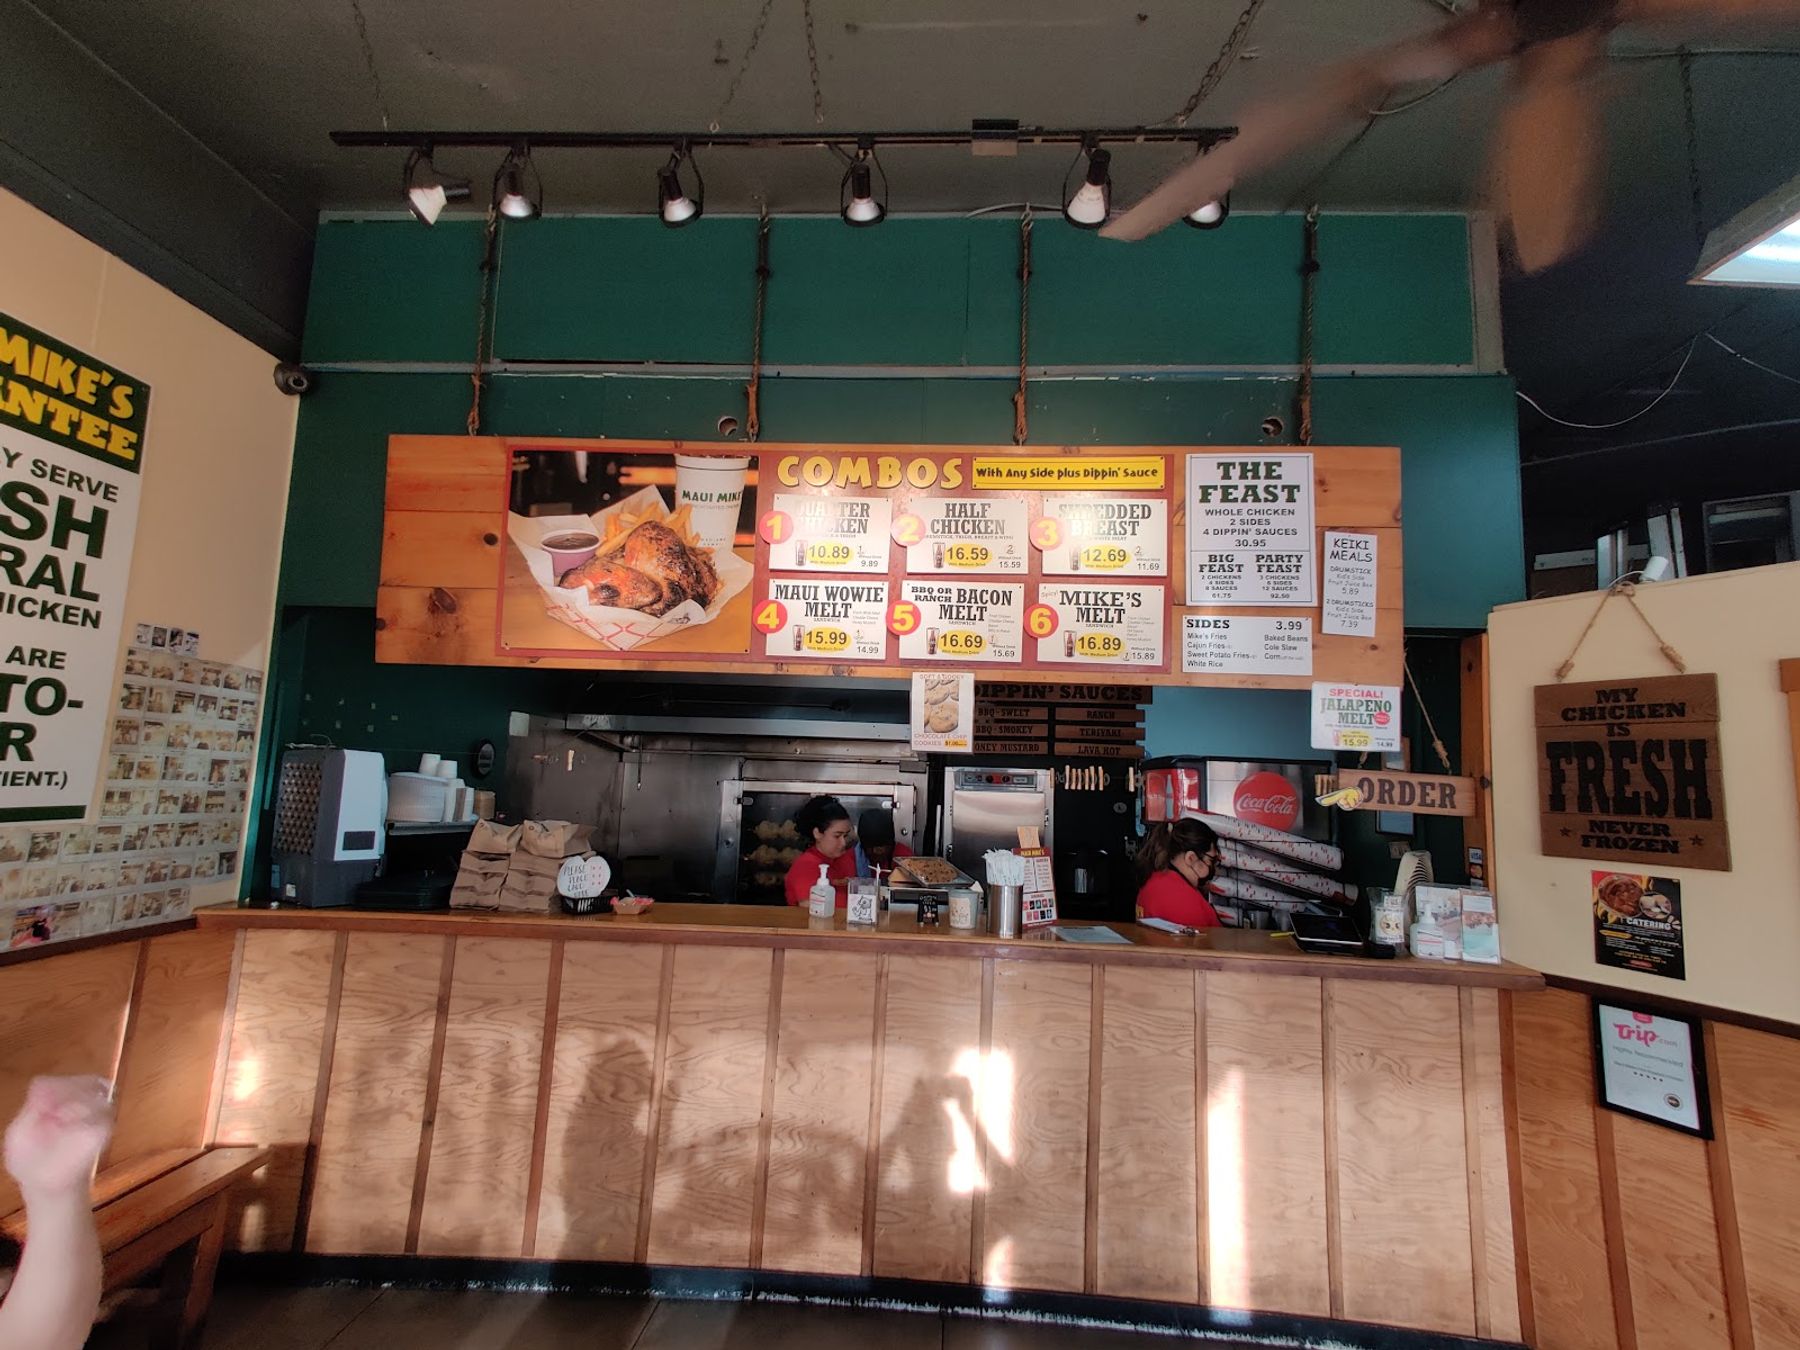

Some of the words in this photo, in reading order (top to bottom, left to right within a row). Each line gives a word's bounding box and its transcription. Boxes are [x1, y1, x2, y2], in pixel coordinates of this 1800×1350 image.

[0, 326, 134, 419] MIKE'S
[777, 456, 963, 489] COMBOS
[976, 467, 1002, 478] With
[1006, 468, 1027, 479] Any
[1030, 468, 1054, 478] Side
[1058, 467, 1080, 480] plus
[1084, 467, 1120, 480] Dippin'
[1123, 468, 1158, 478] Sauce
[1217, 462, 1282, 480] THE
[30, 458, 119, 503] SERVE
[682, 490, 713, 502] MAUI
[1199, 484, 1300, 503] FEAST
[945, 503, 992, 518] HALF
[1059, 504, 1152, 520] SHREDDED
[766, 515, 782, 540] 1
[899, 516, 920, 542] 2
[930, 520, 1006, 534] CHICKEN
[1037, 520, 1058, 546] 3
[1235, 539, 1266, 547] 30.95
[1334, 538, 1369, 550] KEIKI
[810, 545, 850, 559] 10.89
[947, 548, 988, 560] 16.59
[1084, 549, 1126, 562] 12.69
[1208, 554, 1234, 562] BIG
[1256, 554, 1304, 562] PARTY
[1330, 550, 1372, 562] MEALS
[1199, 564, 1244, 572] FEAST
[1257, 564, 1302, 572] FEAST
[1330, 566, 1372, 574] DRUMSTICK
[775, 584, 819, 600] MAUI
[825, 586, 884, 602] WOWIE
[912, 586, 934, 594] BBQ
[956, 588, 1012, 606] BACON
[1060, 590, 1142, 608] MIKE'S
[757, 603, 780, 629] 4
[805, 602, 852, 618] MELT
[939, 604, 988, 621] MELT
[1076, 608, 1126, 624] MELT
[892, 604, 914, 632] 5
[1030, 608, 1052, 634] 6
[1186, 619, 1230, 628] SIDES
[1276, 621, 1302, 630] 3.99
[806, 632, 848, 645] 15.99
[941, 634, 982, 648] 16.69
[1078, 636, 1122, 651] 16.89
[5, 646, 66, 670] ARE
[1060, 686, 1143, 700] SAUCES
[1329, 688, 1384, 698] SPECIAL!
[1596, 688, 1638, 704] MY
[1320, 698, 1392, 714] JALAPENO
[1561, 703, 1686, 722] CHICKEN
[1086, 710, 1115, 719] RANCH
[1338, 712, 1374, 724] MELT
[999, 726, 1032, 734] SMOKEY
[1080, 728, 1121, 736] TERIYAKI
[1607, 723, 1630, 736] IS
[975, 743, 996, 752] ONEY
[1000, 744, 1040, 752] MUSTARD
[1078, 746, 1099, 754] LAVA
[1102, 747, 1121, 755] HOT
[0, 770, 67, 790] IENT.)
[1546, 739, 1713, 820] FRESH
[1358, 776, 1456, 808] ORDER
[1589, 820, 1671, 836] NEVER
[1582, 835, 1680, 854] FROZEN
[1626, 918, 1672, 930] CATERING
